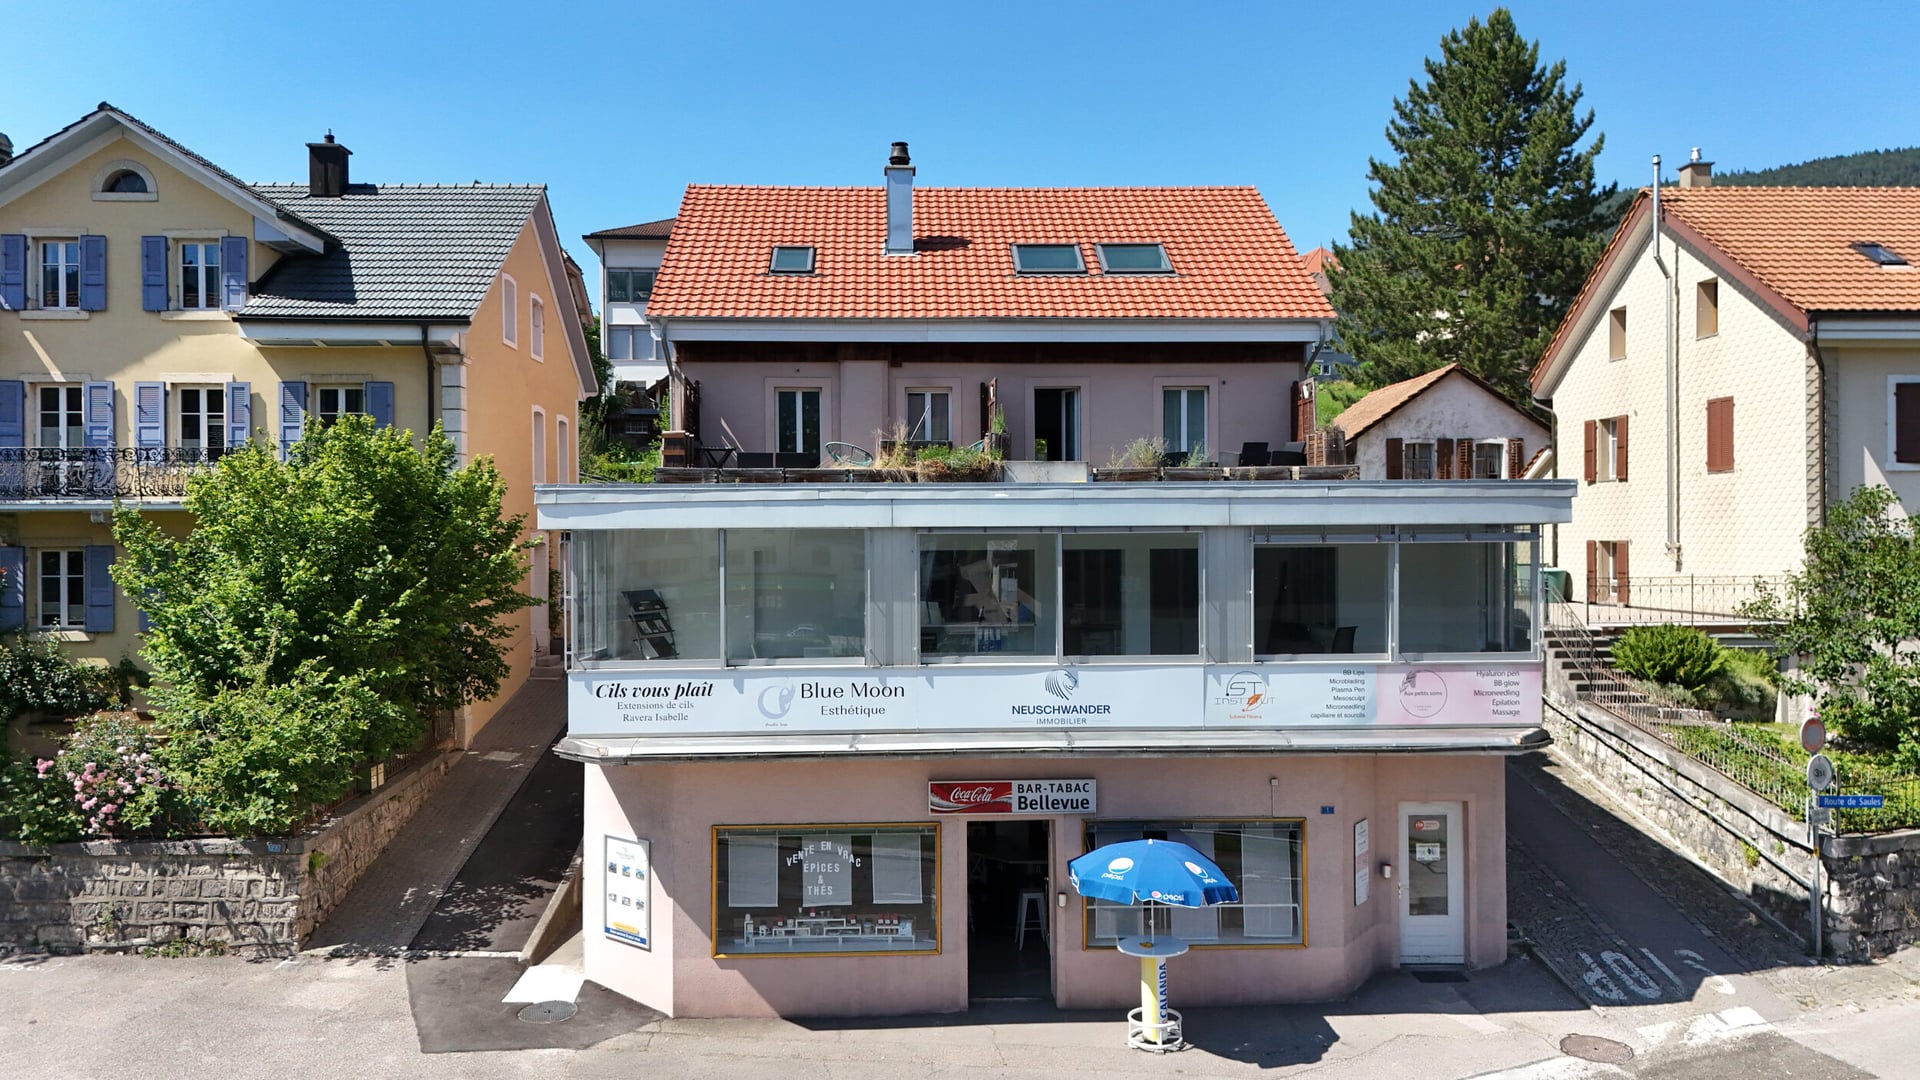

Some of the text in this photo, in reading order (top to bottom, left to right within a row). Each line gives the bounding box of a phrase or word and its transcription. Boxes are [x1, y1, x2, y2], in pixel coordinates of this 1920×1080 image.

[1477, 670, 1506, 678] Hyaluron
[1229, 681, 1263, 697] ST
[1503, 680, 1520, 688] glow
[596, 681, 714, 700] Cils vous plaît
[801, 682, 905, 699] Blue Moon
[617, 701, 694, 710] Extensions de cils
[1012, 705, 1112, 715] NEUSCHWANDER
[821, 705, 886, 718] Esthétique
[1492, 709, 1520, 717] Massage
[623, 713, 689, 722] Ravera Isabelle
[1018, 783, 1090, 793] BAR-TABAC
[950, 786, 994, 803] Coca-Cola
[1018, 795, 1090, 810] Bellevue
[1824, 797, 1881, 806] Route de Saules
[786, 841, 861, 867] VENTE EN VRAC
[817, 874, 824, 884] &
[1162, 893, 1185, 902] pepsi
